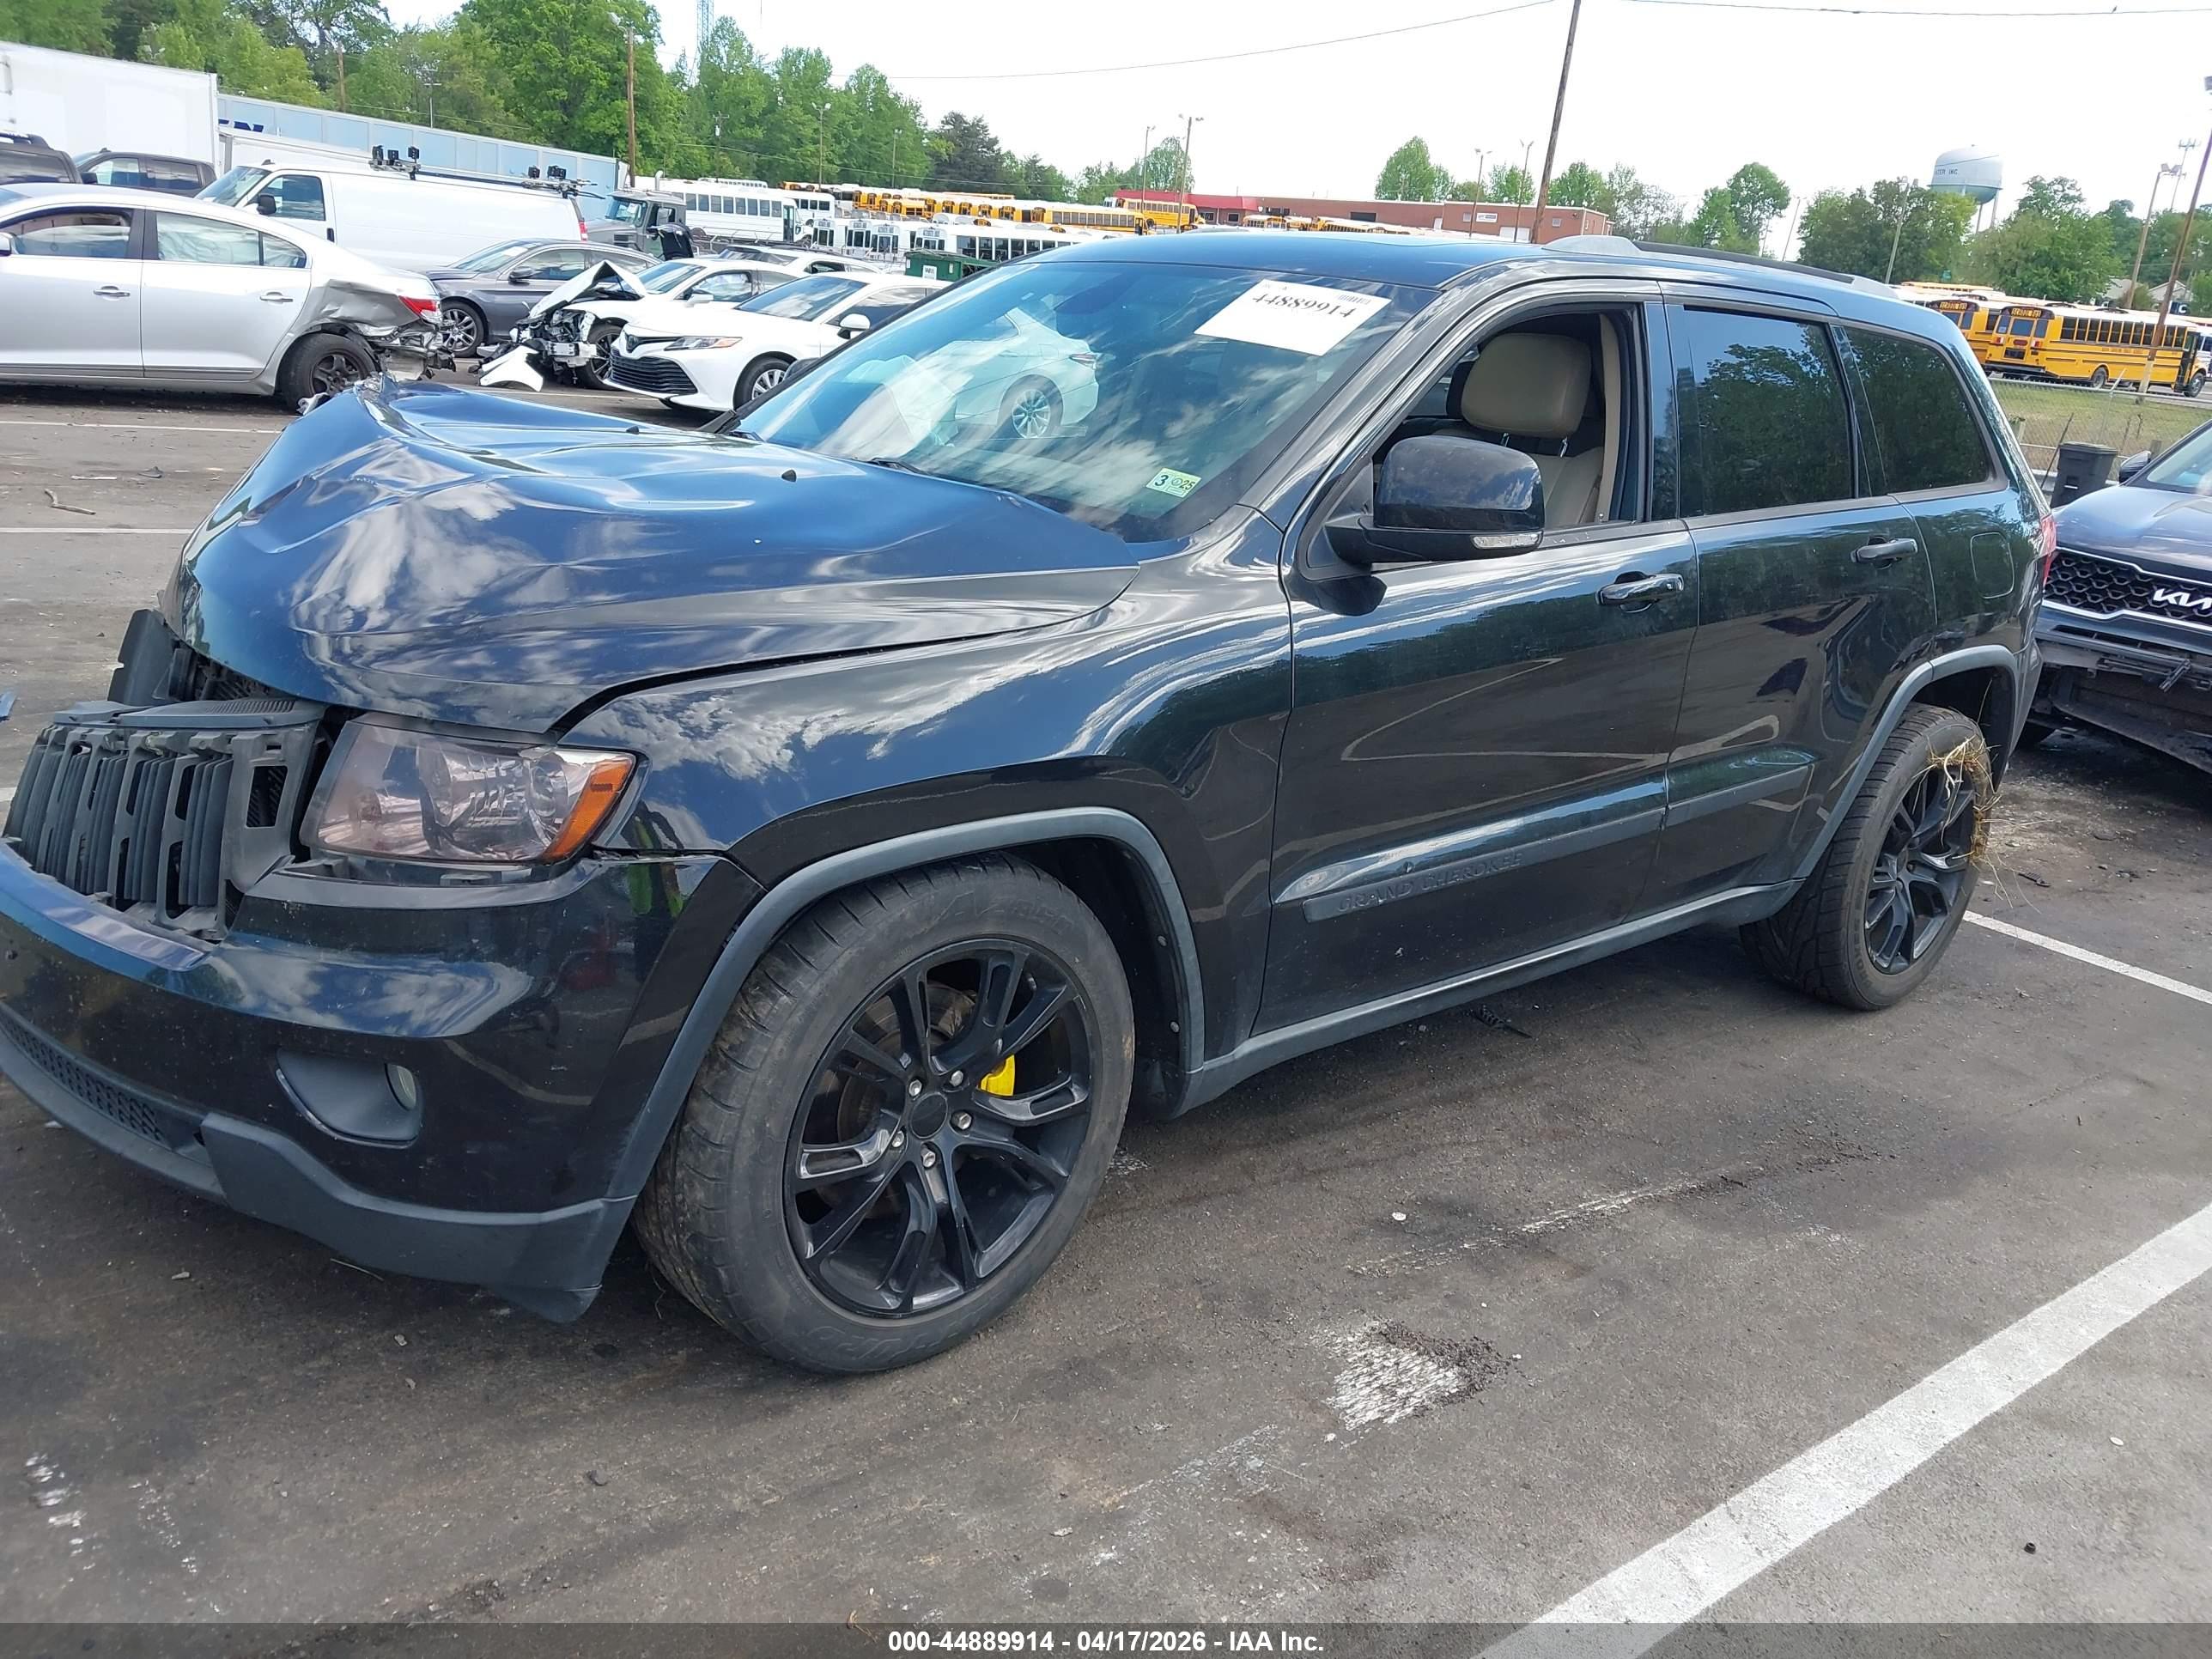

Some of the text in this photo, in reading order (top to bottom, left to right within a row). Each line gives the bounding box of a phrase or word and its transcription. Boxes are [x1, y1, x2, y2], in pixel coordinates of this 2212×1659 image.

[1252, 293, 1357, 318] 44889914
[1154, 474, 1196, 490] 3 25
[2153, 587, 2212, 611] KIA
[1336, 849, 1525, 913] GRAND CHEROKEE
